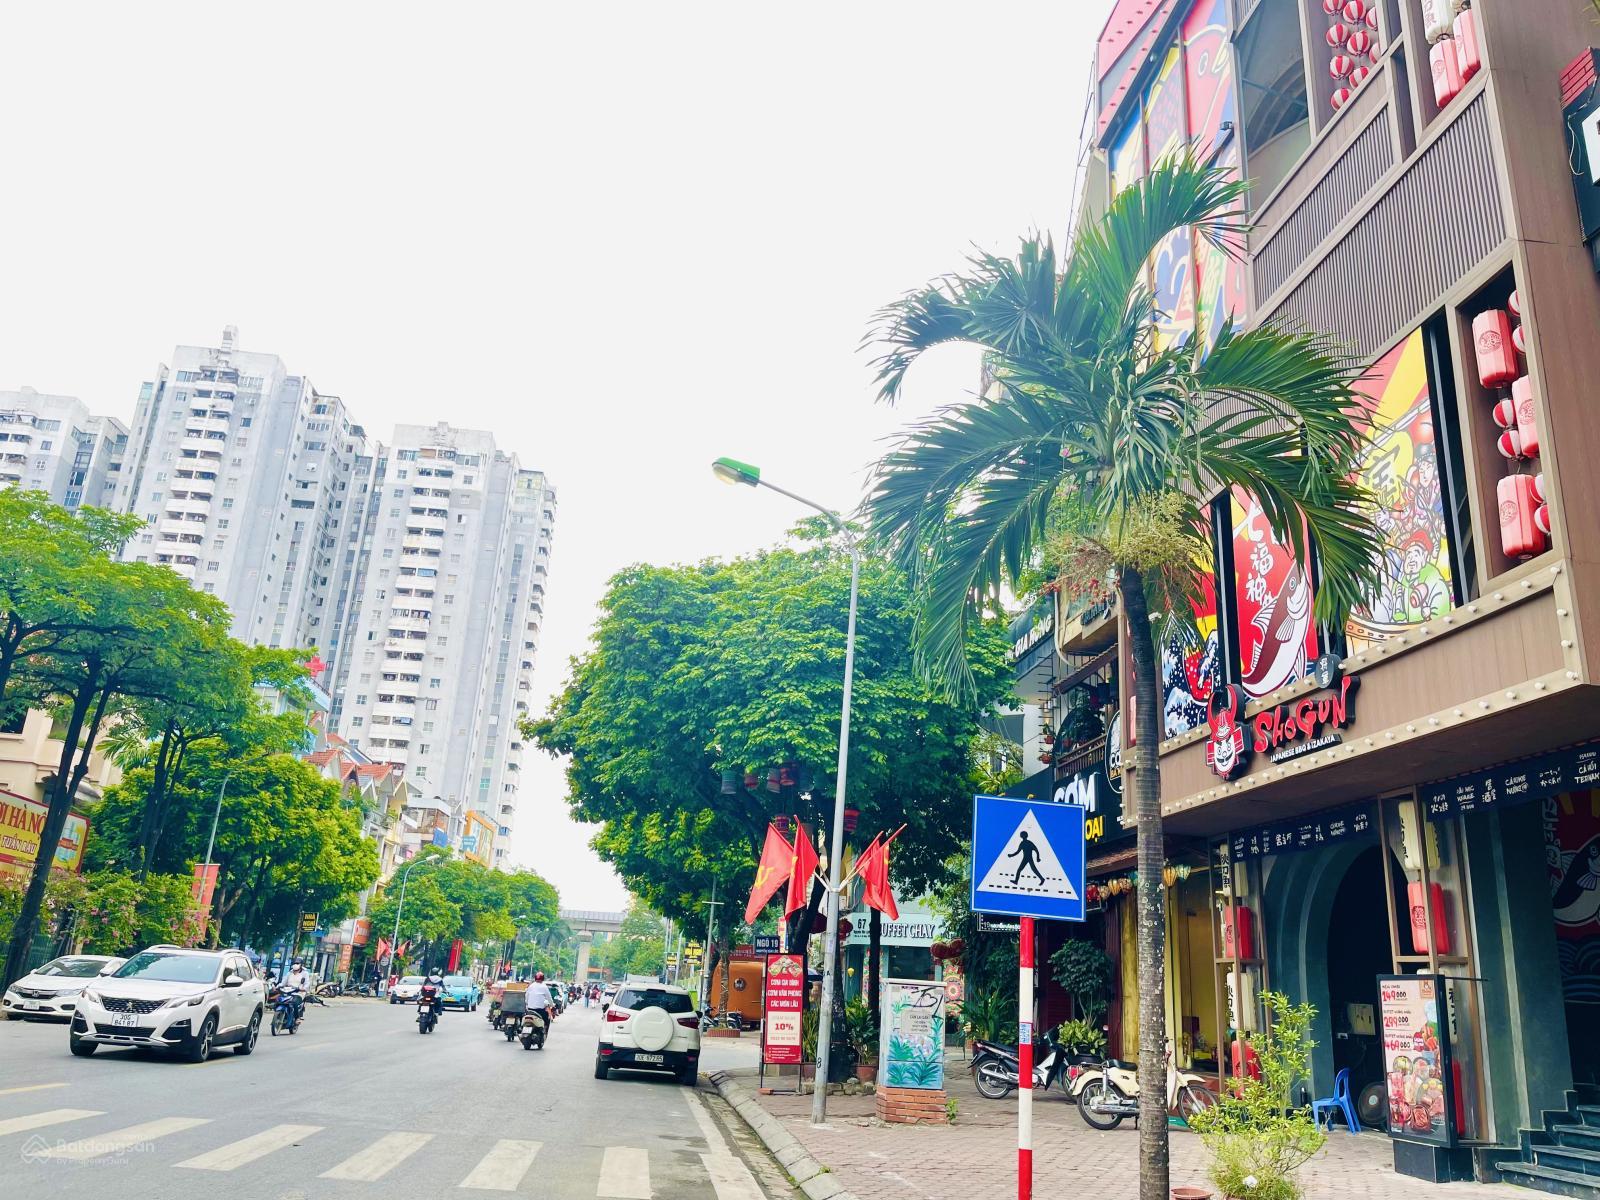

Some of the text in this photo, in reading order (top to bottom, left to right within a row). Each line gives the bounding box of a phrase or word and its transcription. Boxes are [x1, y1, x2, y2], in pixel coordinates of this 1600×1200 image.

[1270, 748, 1295, 763] JAPANESE
[1295, 745, 1307, 756] BBQ
[1311, 734, 1336, 749] IZAKAYA
[1085, 815, 1104, 842] OẠI
[857, 919, 867, 929] 67
[880, 923, 908, 938] UFFET
[909, 924, 935, 938] CHAY
[771, 939, 779, 948] 19
[1382, 990, 1395, 1001] 149
[775, 1023, 794, 1031] 10%
